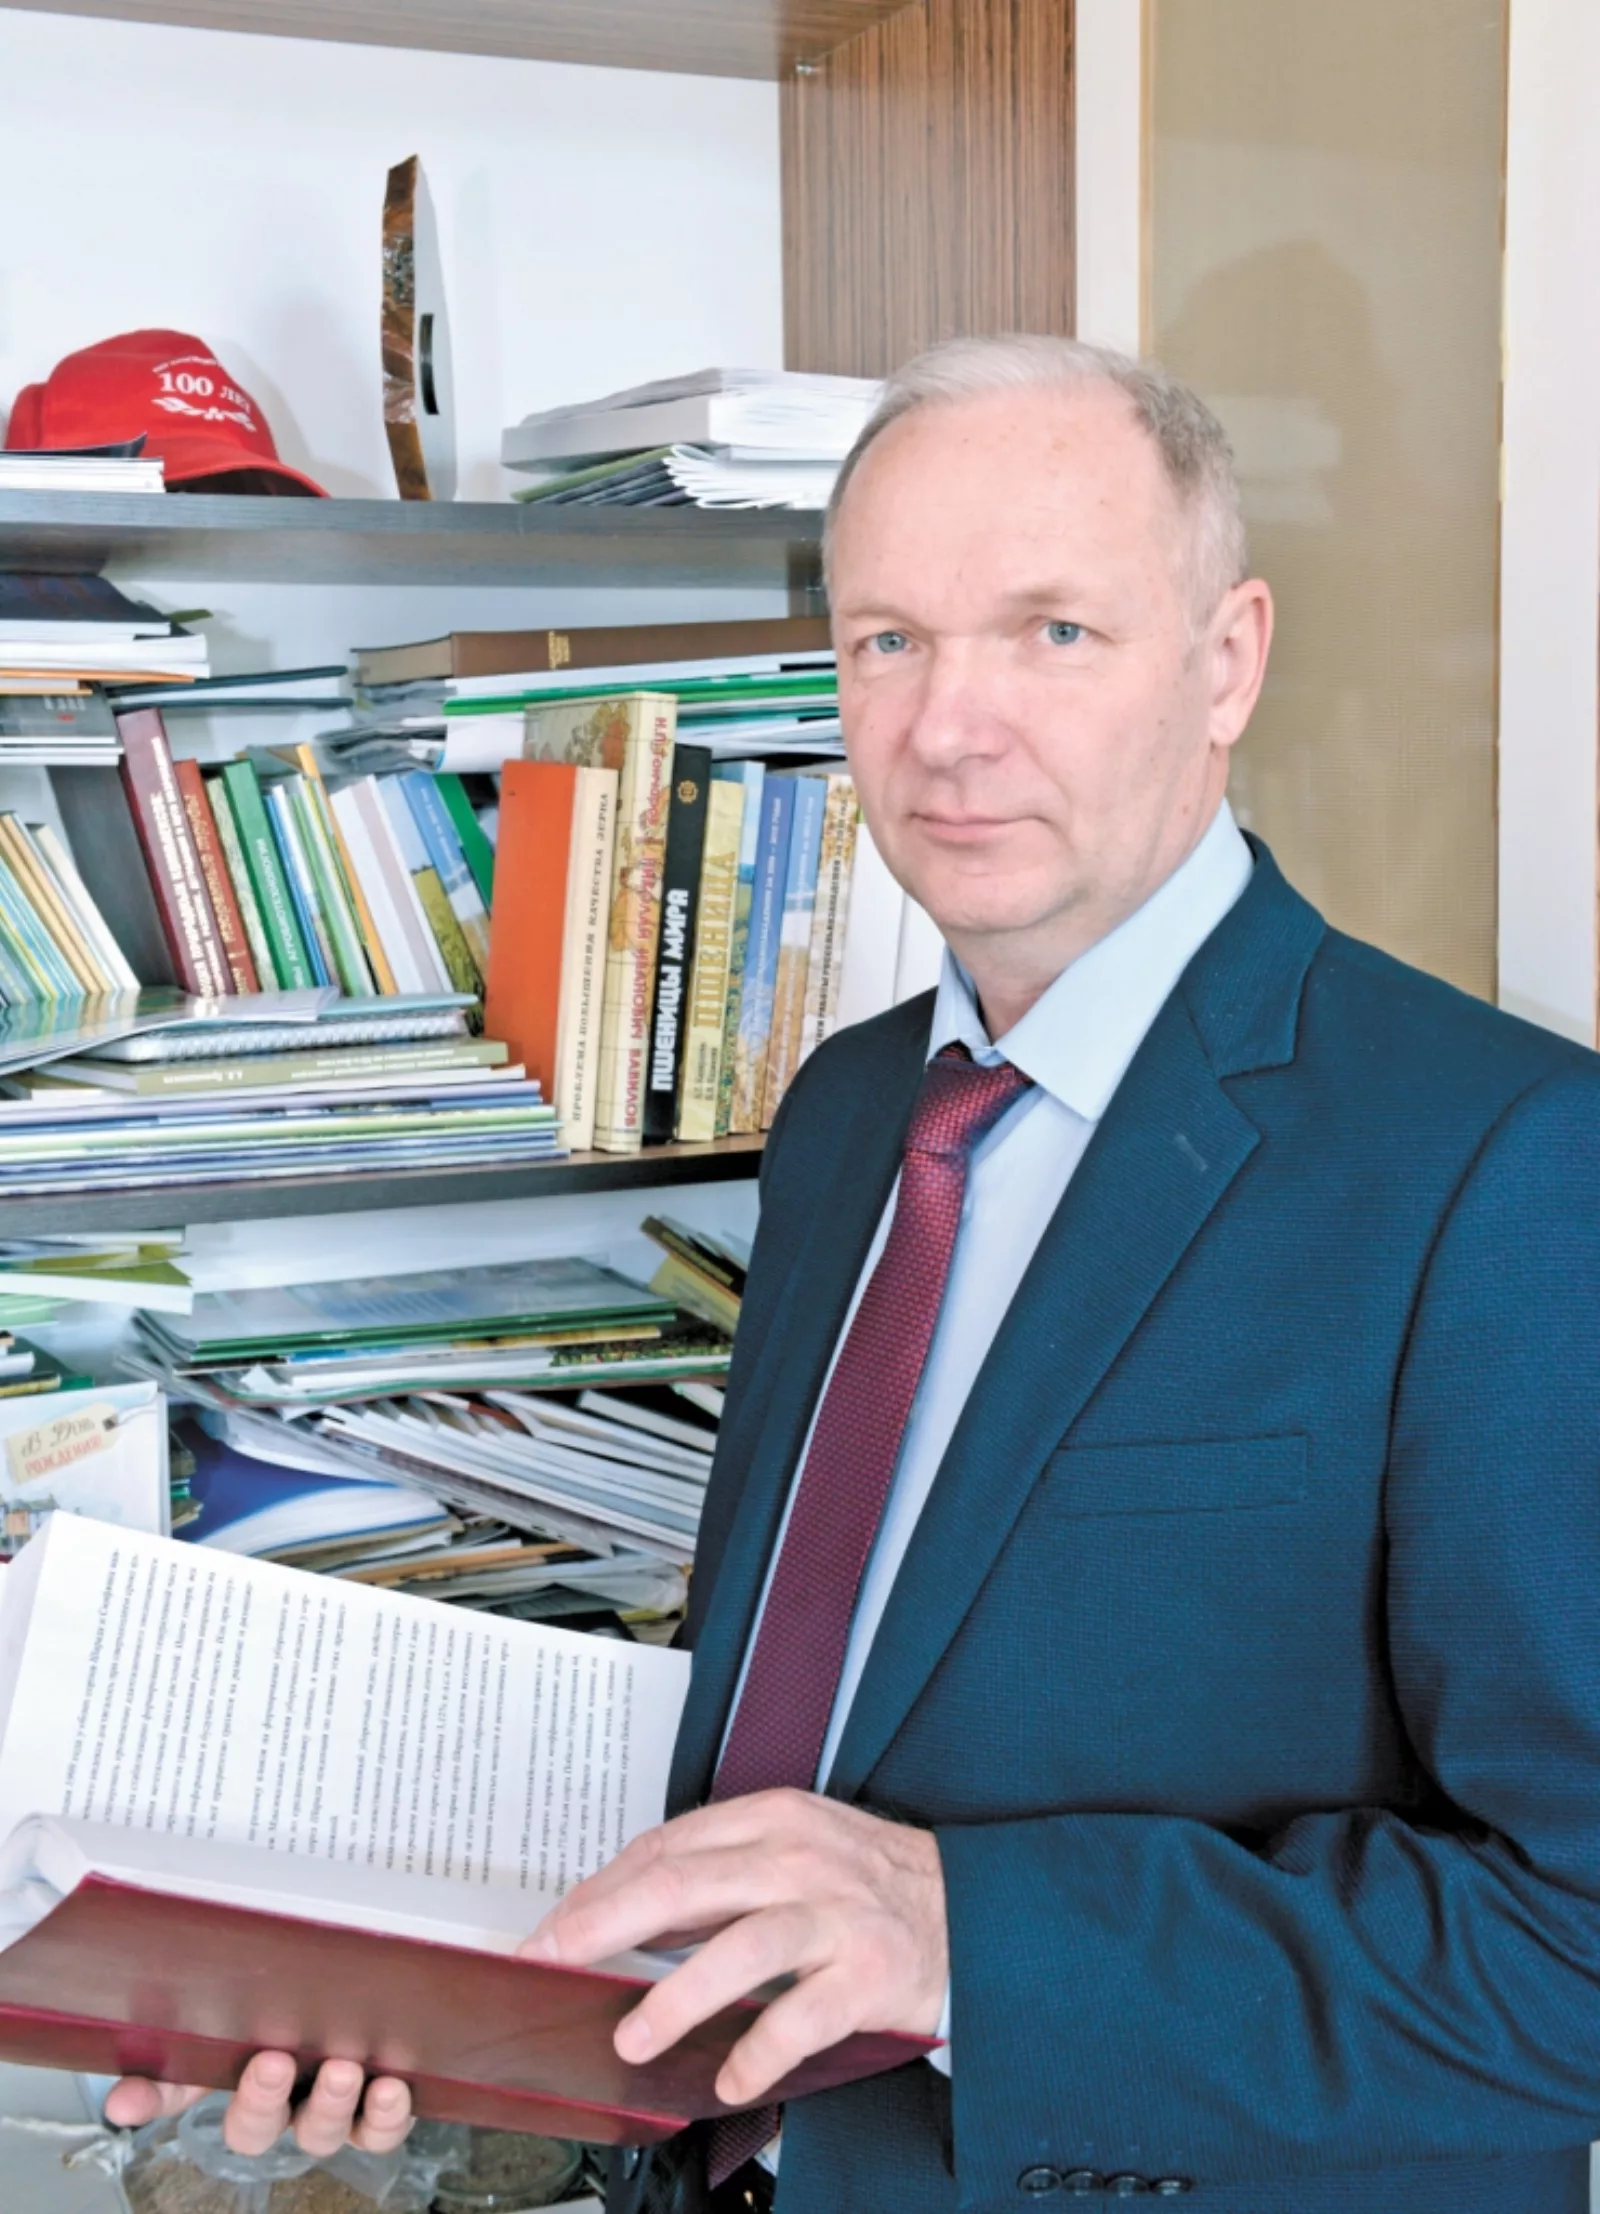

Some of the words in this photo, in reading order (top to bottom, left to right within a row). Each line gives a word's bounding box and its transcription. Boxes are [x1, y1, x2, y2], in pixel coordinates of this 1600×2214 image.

[159, 372, 214, 396] 100
[595, 792, 608, 841] ЗЕРНА
[588, 848, 603, 925] КАЧЕСТВА
[635, 858, 657, 939] НИКОЛАЙ
[663, 888, 690, 961] МИРА
[693, 851, 737, 1028] ПШЕНИЦА
[577, 932, 595, 1035] ПОВЫШЕНИЯ
[629, 947, 649, 1039] ИВАНОВИЧ
[652, 964, 683, 1092] ПШЕНИЦЫ
[571, 1039, 586, 1121] ПРОБЛЕМА
[623, 1047, 641, 1128] ВАВИЛОВ
